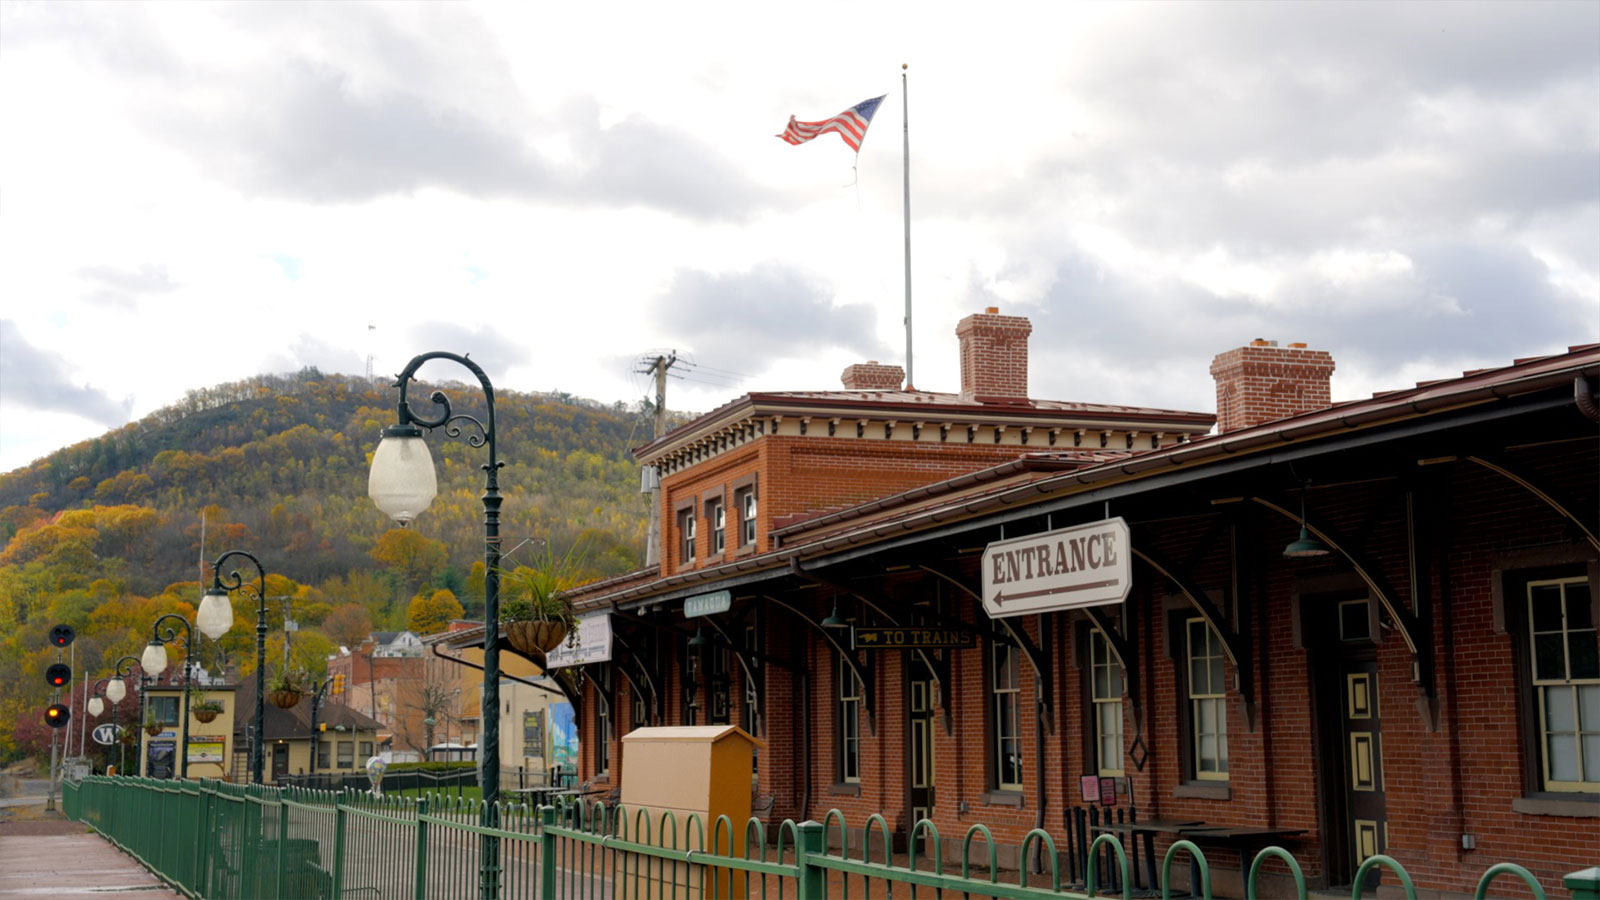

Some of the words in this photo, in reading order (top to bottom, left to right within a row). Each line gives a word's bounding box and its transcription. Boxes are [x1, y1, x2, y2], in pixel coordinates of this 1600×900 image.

[991, 531, 1117, 585] ENTRANCE
[884, 631, 905, 645] TO
[911, 631, 971, 645] TRAINS
